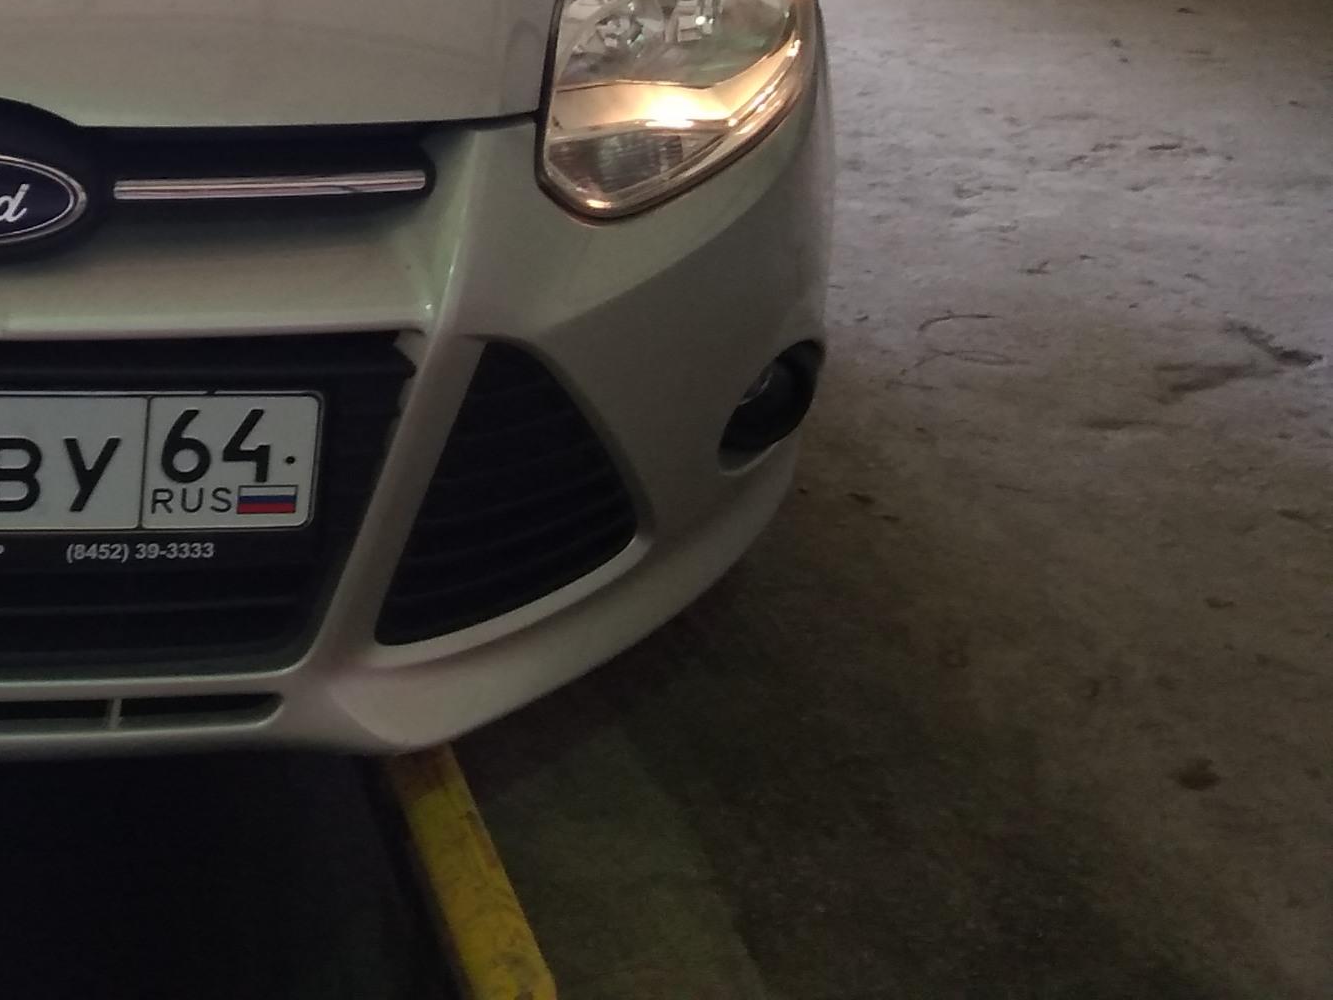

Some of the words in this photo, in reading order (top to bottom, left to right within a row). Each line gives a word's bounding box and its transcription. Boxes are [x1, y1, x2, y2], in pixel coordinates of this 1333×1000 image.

[161, 409, 271, 484] 64
[151, 487, 232, 514] RUS
[66, 542, 130, 564] (8452)
[134, 541, 216, 560] 39-3333
